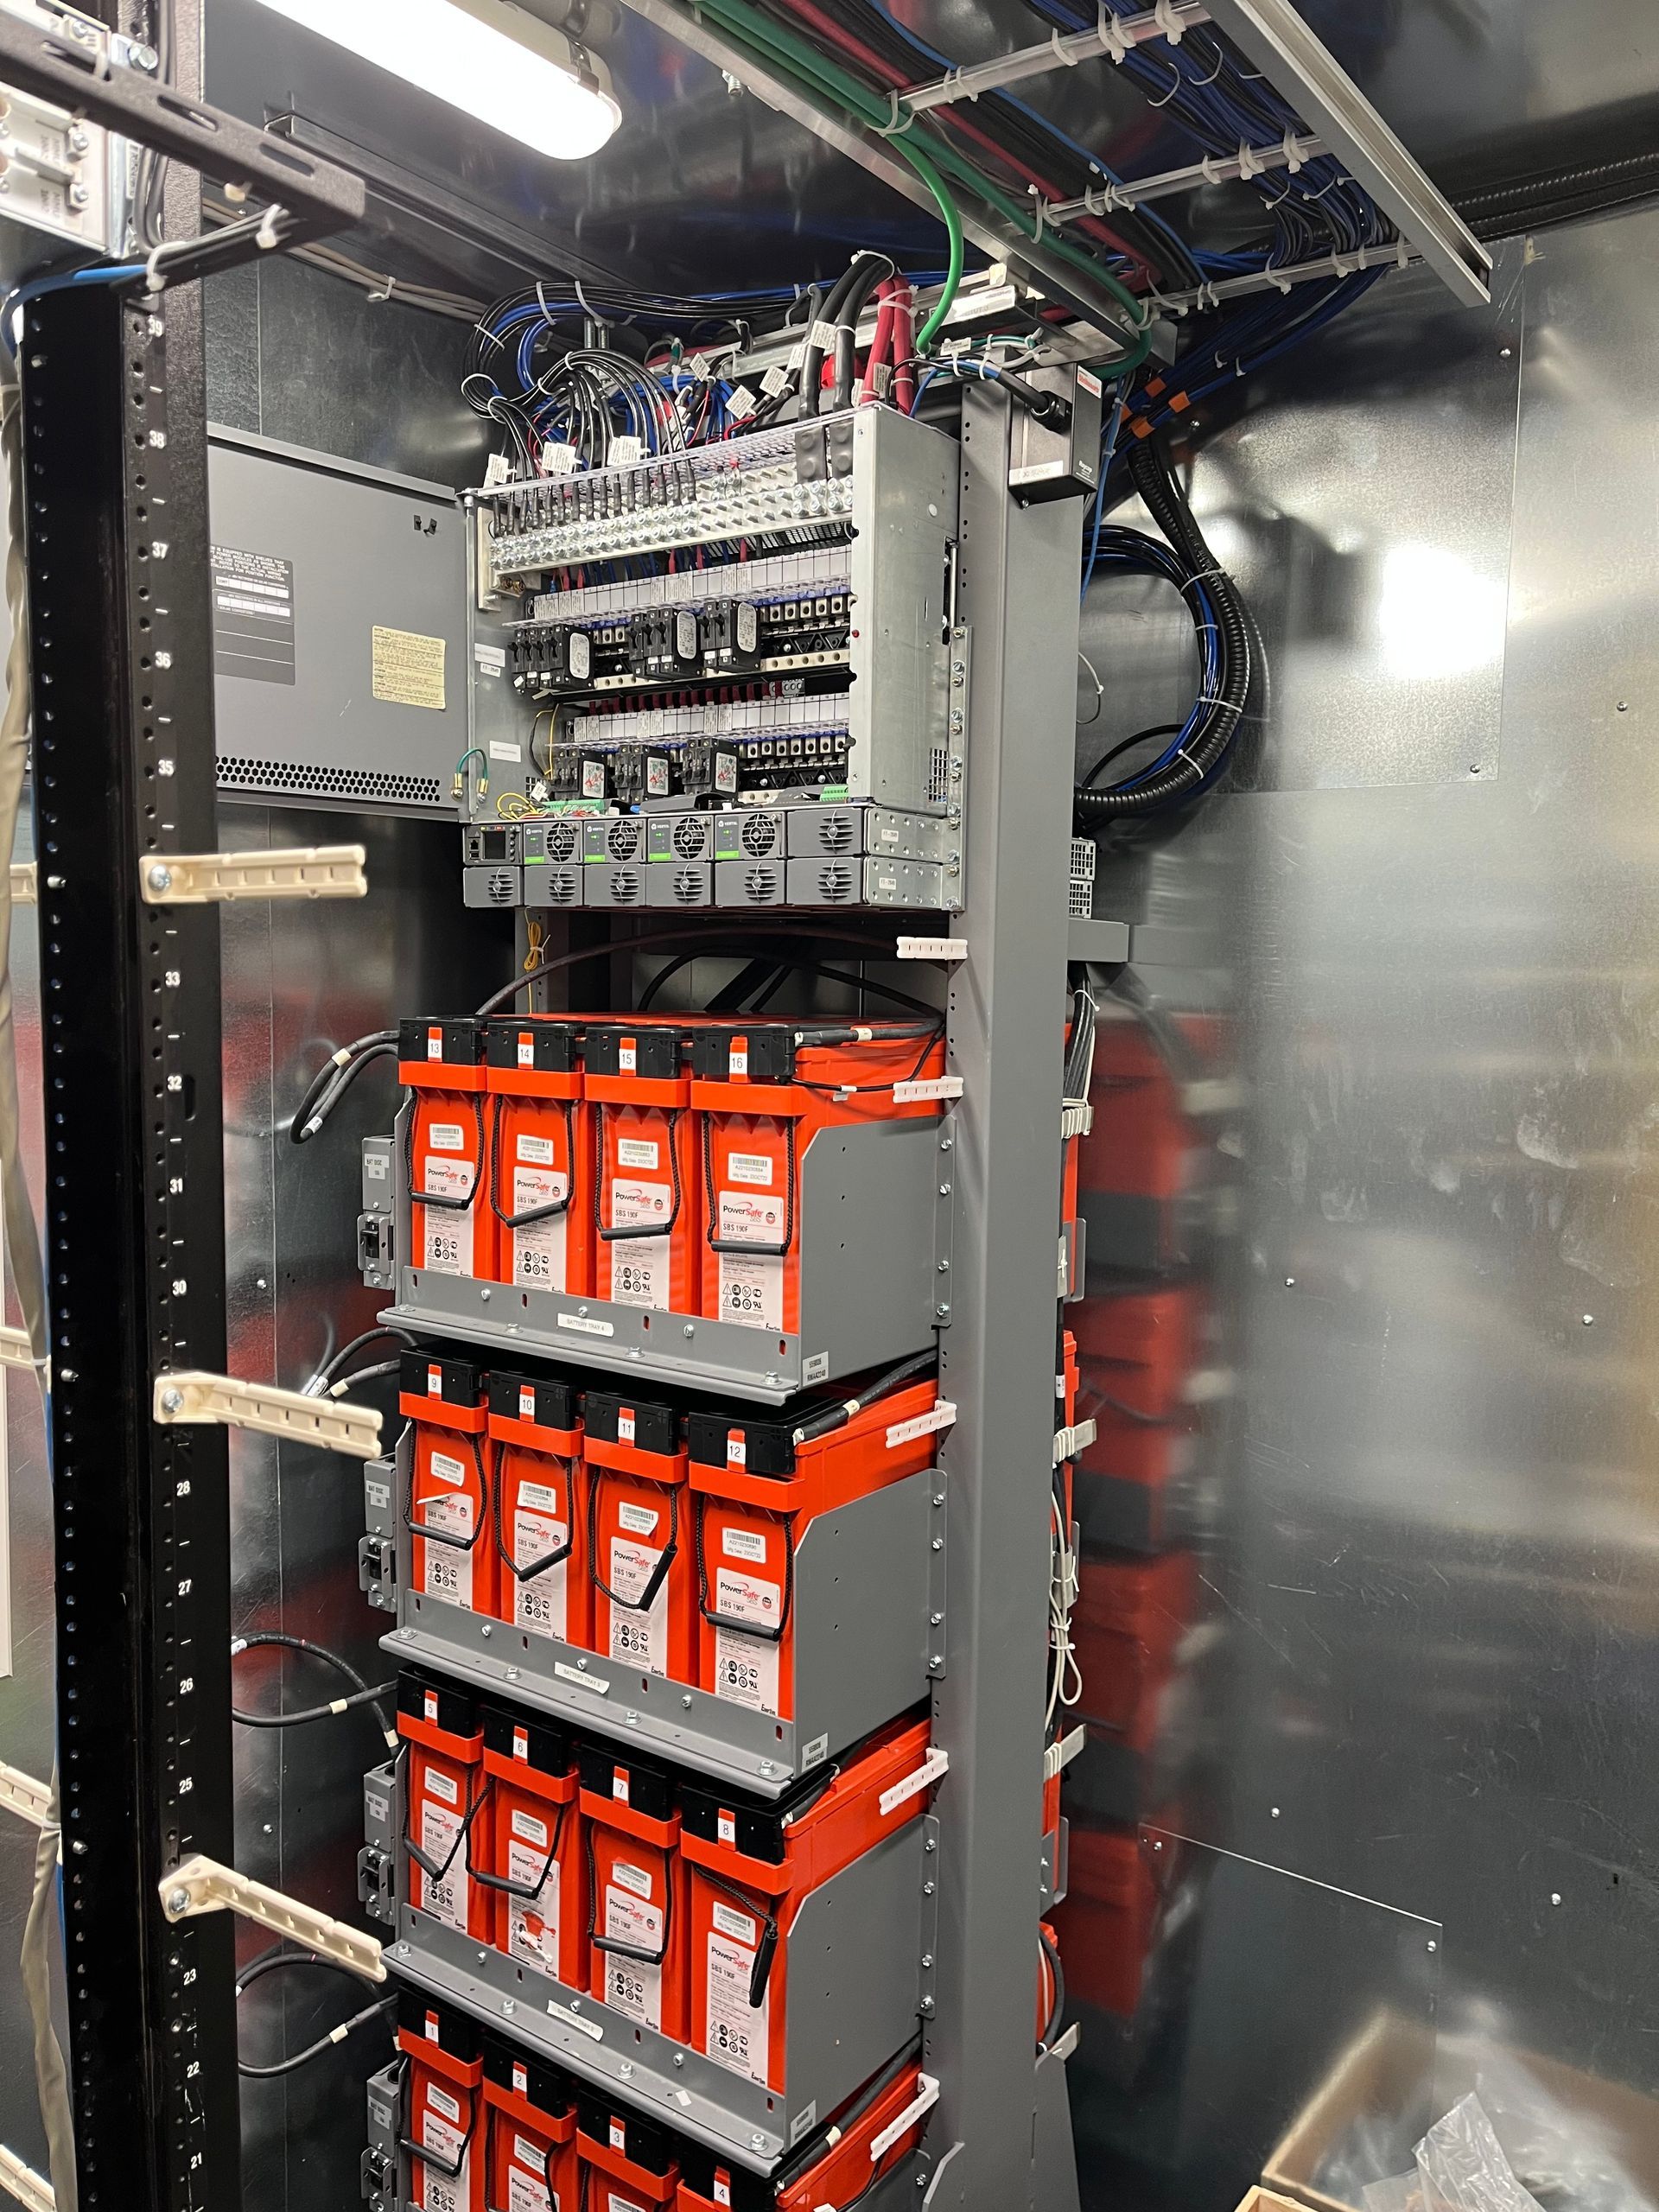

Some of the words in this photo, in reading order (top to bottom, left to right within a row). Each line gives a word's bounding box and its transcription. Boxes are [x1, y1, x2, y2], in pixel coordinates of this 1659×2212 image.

[148, 317, 163, 337] 39
[149, 430, 165, 448] 38
[152, 541, 168, 559] 37
[155, 652, 171, 669] 36
[158, 760, 175, 776] 35
[165, 972, 181, 987] 33
[430, 1044, 439, 1053] 13
[520, 1049, 530, 1058] 14
[622, 1053, 632, 1065] 15
[732, 1058, 742, 1068] 16
[168, 1076, 182, 1091] 32
[428, 1168, 459, 1180] PowerSafe
[170, 1179, 182, 1193] 31
[517, 1179, 550, 1192] PowerSafe
[615, 1192, 652, 1205] PowerSafe
[723, 1205, 763, 1218] PowerSafe
[173, 1280, 187, 1294] 30
[567, 1319, 587, 1328] BATTERY
[431, 1378, 437, 1388] 9
[523, 1399, 532, 1410] 10
[622, 1423, 631, 1433] 11
[730, 1446, 741, 1458] 12
[176, 1480, 190, 1497] 28
[518, 1522, 550, 1538] PowerSafe
[614, 1550, 650, 1568] PowerSafe
[614, 1567, 624, 1576] SBS
[178, 1580, 192, 1595] 27
[720, 1582, 760, 1600] PowerSafe
[720, 1599, 732, 1609] SBS
[180, 1677, 194, 1694] 26
[428, 1704, 433, 1713] 5
[518, 1742, 523, 1751] 6
[179, 1777, 193, 1794] 25
[619, 1783, 624, 1794] 7
[723, 1825, 729, 1835] 8
[609, 1898, 645, 1921] PowerSafe
[711, 1946, 750, 1970] PowerSafe
[183, 1968, 197, 1986] 23
[431, 2027, 434, 2036] 1
[187, 2061, 200, 2078] 22
[517, 2075, 522, 2085] 2
[614, 2133, 620, 2142] 3
[191, 2152, 202, 2170] 21
[719, 2189, 725, 2198] 4
